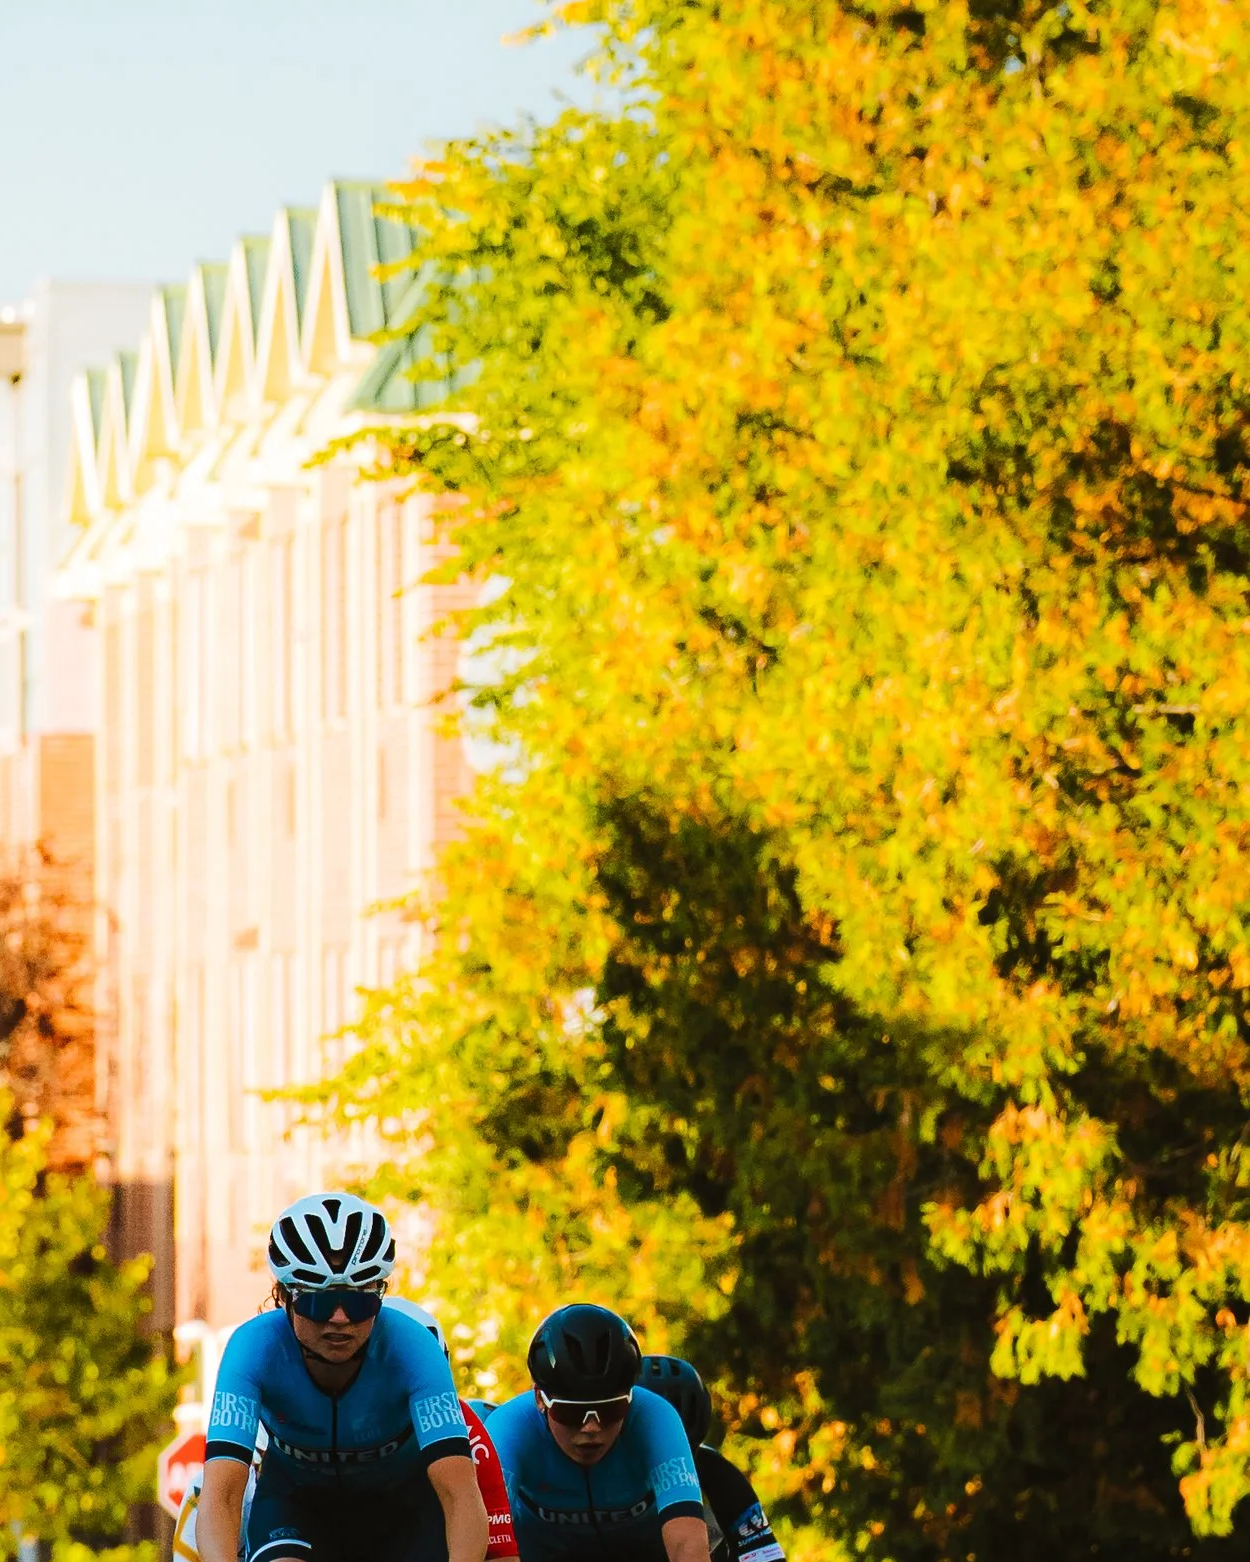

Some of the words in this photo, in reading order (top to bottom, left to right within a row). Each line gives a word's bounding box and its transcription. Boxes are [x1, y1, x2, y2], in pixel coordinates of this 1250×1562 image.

[213, 1391, 258, 1418] FIRST
[415, 1390, 458, 1417] FIRST
[272, 1435, 399, 1463] UNITED
[486, 1513, 512, 1525] PMG
[538, 1500, 648, 1525] UNITED
